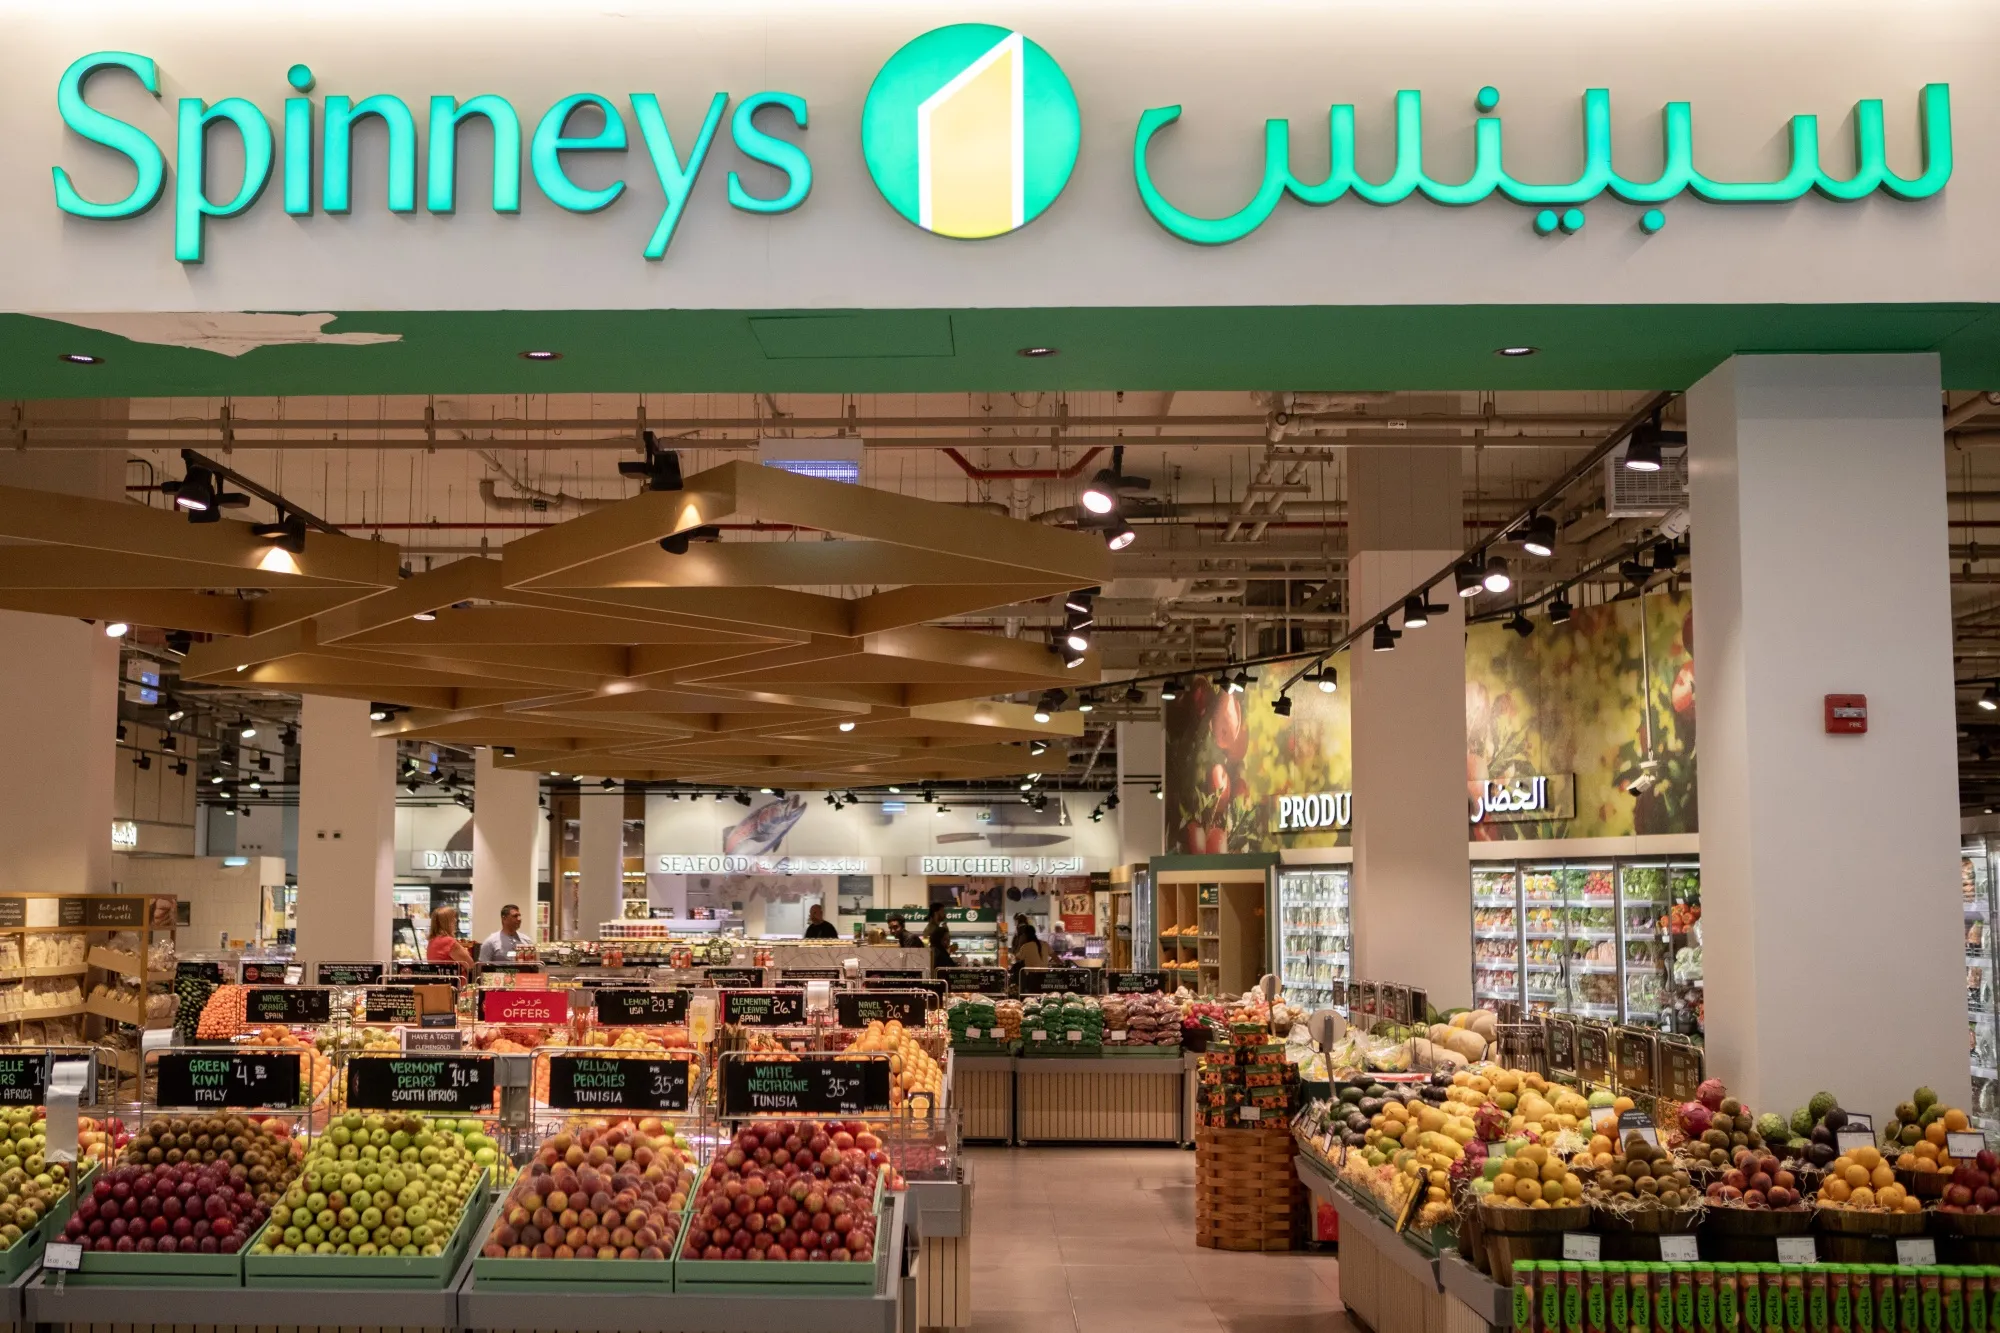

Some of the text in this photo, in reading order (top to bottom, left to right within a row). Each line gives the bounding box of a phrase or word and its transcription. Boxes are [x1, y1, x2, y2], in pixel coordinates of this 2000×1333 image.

[52, 51, 813, 264] Spinneys
[1133, 82, 1953, 246] سبينس
[426, 852, 473, 867] DAIR
[660, 857, 748, 872] SEAFOOD
[923, 858, 1012, 873] BUTCHER
[262, 995, 286, 1003] NAVEL
[512, 997, 542, 1007] عروض
[623, 998, 650, 1006] LEMON
[732, 998, 771, 1006] CLEMENTINE
[858, 1001, 881, 1009] NAVEL
[264, 1012, 284, 1020] SPAIN
[503, 1008, 550, 1018] OFFERS
[629, 1007, 644, 1015] USA
[189, 1059, 230, 1073] GREEN
[390, 1062, 444, 1074] VERMONT
[576, 1060, 620, 1072] YELLOW
[755, 1066, 794, 1078] WHITE
[192, 1074, 224, 1086] KIWI
[398, 1076, 436, 1088] PEARS
[573, 1074, 626, 1088] PEACHES
[748, 1079, 809, 1092] NECTARINE
[4, 1089, 33, 1100] AFRICA
[195, 1089, 228, 1102] ITALY
[392, 1090, 458, 1102] SOUTH AFRICA
[574, 1090, 623, 1103] TUNISIA
[752, 1094, 798, 1108] TUNISIA
[1547, 1293, 1555, 1324] rockit
[1568, 1293, 1576, 1324] rockit
[1594, 1294, 1602, 1325] rockit
[1616, 1294, 1624, 1325] rockit
[1636, 1294, 1644, 1325] rockit
[1662, 1294, 1670, 1325] rockit
[1680, 1294, 1688, 1326] rockit
[1702, 1295, 1710, 1326] rockit
[1724, 1295, 1732, 1326] rockit
[1750, 1295, 1758, 1326] rockit
[1770, 1295, 1778, 1326] rockit
[1791, 1295, 1799, 1327] rockit
[1815, 1295, 1823, 1327] rockit
